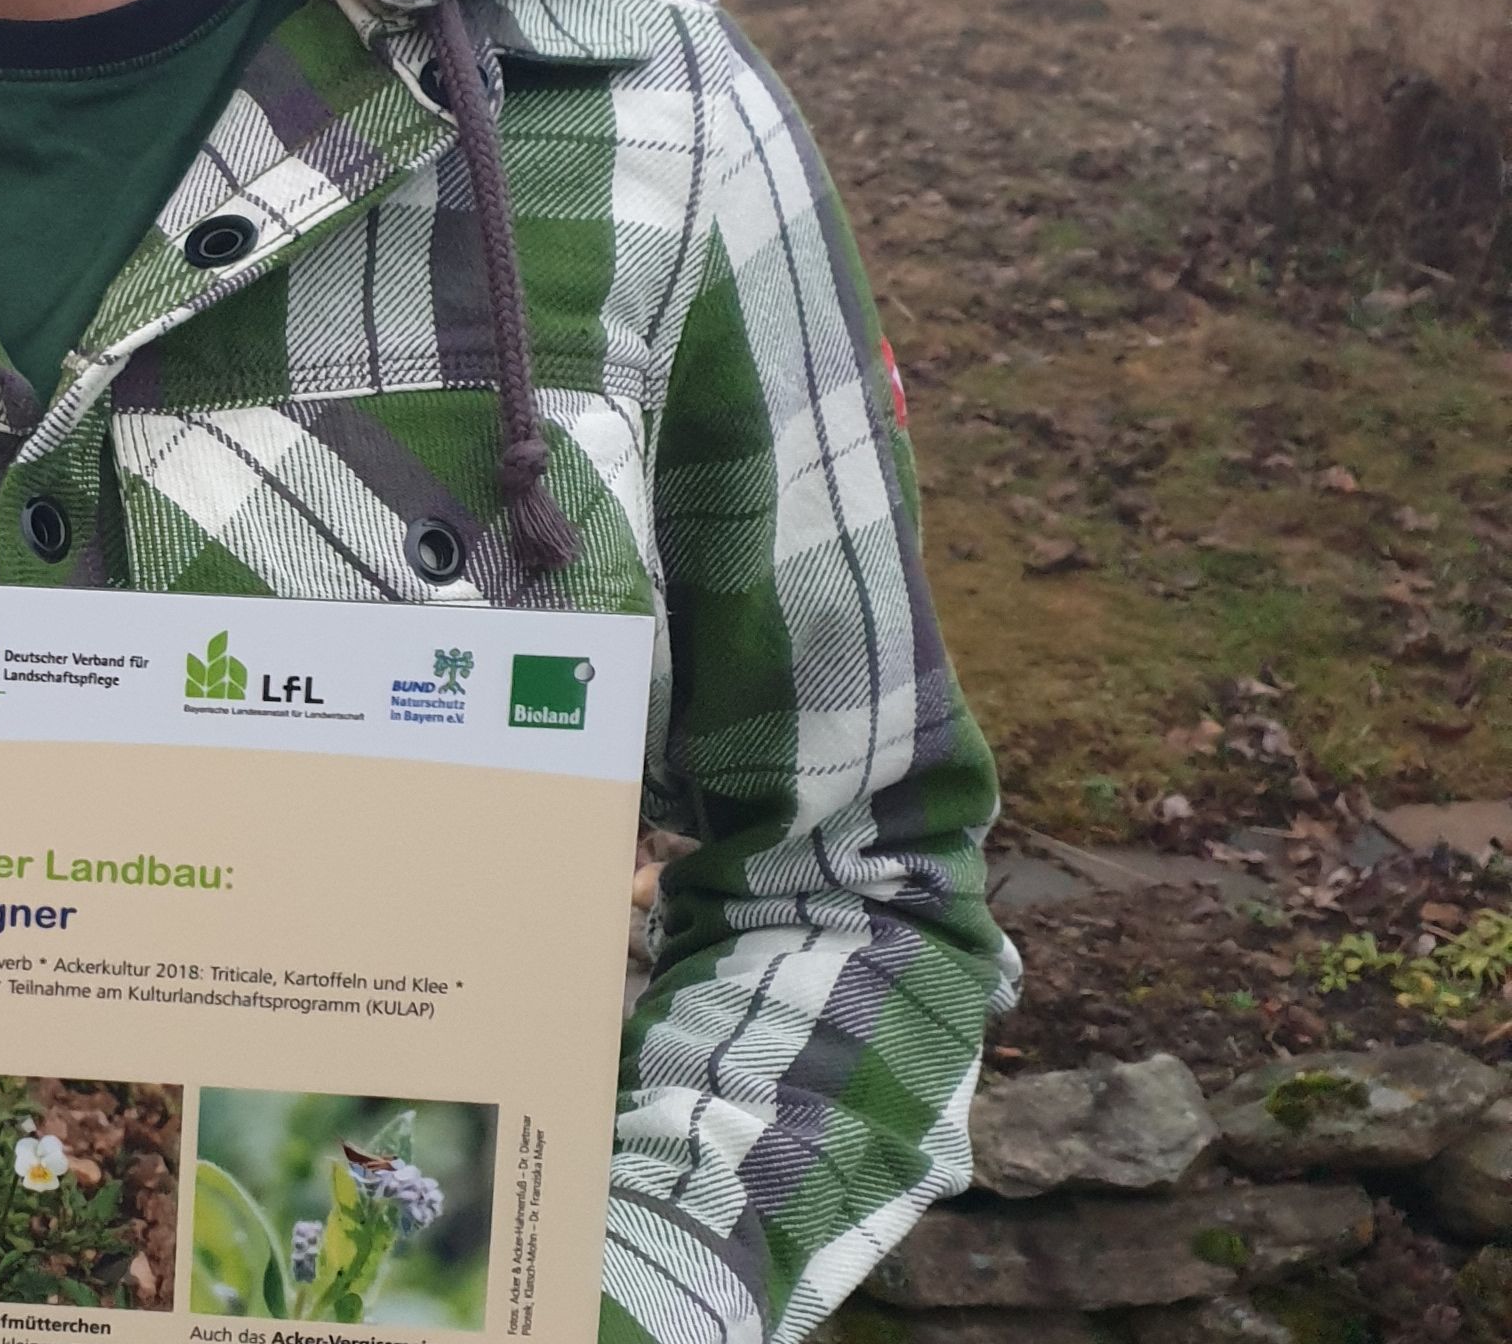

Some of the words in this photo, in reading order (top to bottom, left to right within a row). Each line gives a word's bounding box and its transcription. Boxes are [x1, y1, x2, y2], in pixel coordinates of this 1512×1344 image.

[4, 649, 69, 666] Deutscher
[71, 652, 126, 668] Verband
[129, 655, 150, 669] für
[3, 668, 120, 690] Landschaftspflege
[261, 674, 325, 705] LfL
[391, 680, 435, 695] BUND
[390, 695, 466, 711] Naturschutz
[390, 709, 403, 722] in
[403, 710, 445, 725] Bayern
[514, 704, 582, 726] Bioland
[45, 849, 234, 891] Landbau:
[53, 957, 152, 978] Ackerkultur
[155, 962, 205, 981] 2018:
[210, 966, 277, 988] Triticale,
[284, 970, 368, 990] Kartoffeln
[373, 976, 407, 992] und
[412, 977, 449, 995] Klee
[7, 979, 92, 999] Teilnahme
[96, 986, 123, 1001] am
[128, 985, 361, 1016] Kulturlandschaftsprogramm
[365, 999, 435, 1020] (KULAP)
[189, 1326, 233, 1343] Auch
